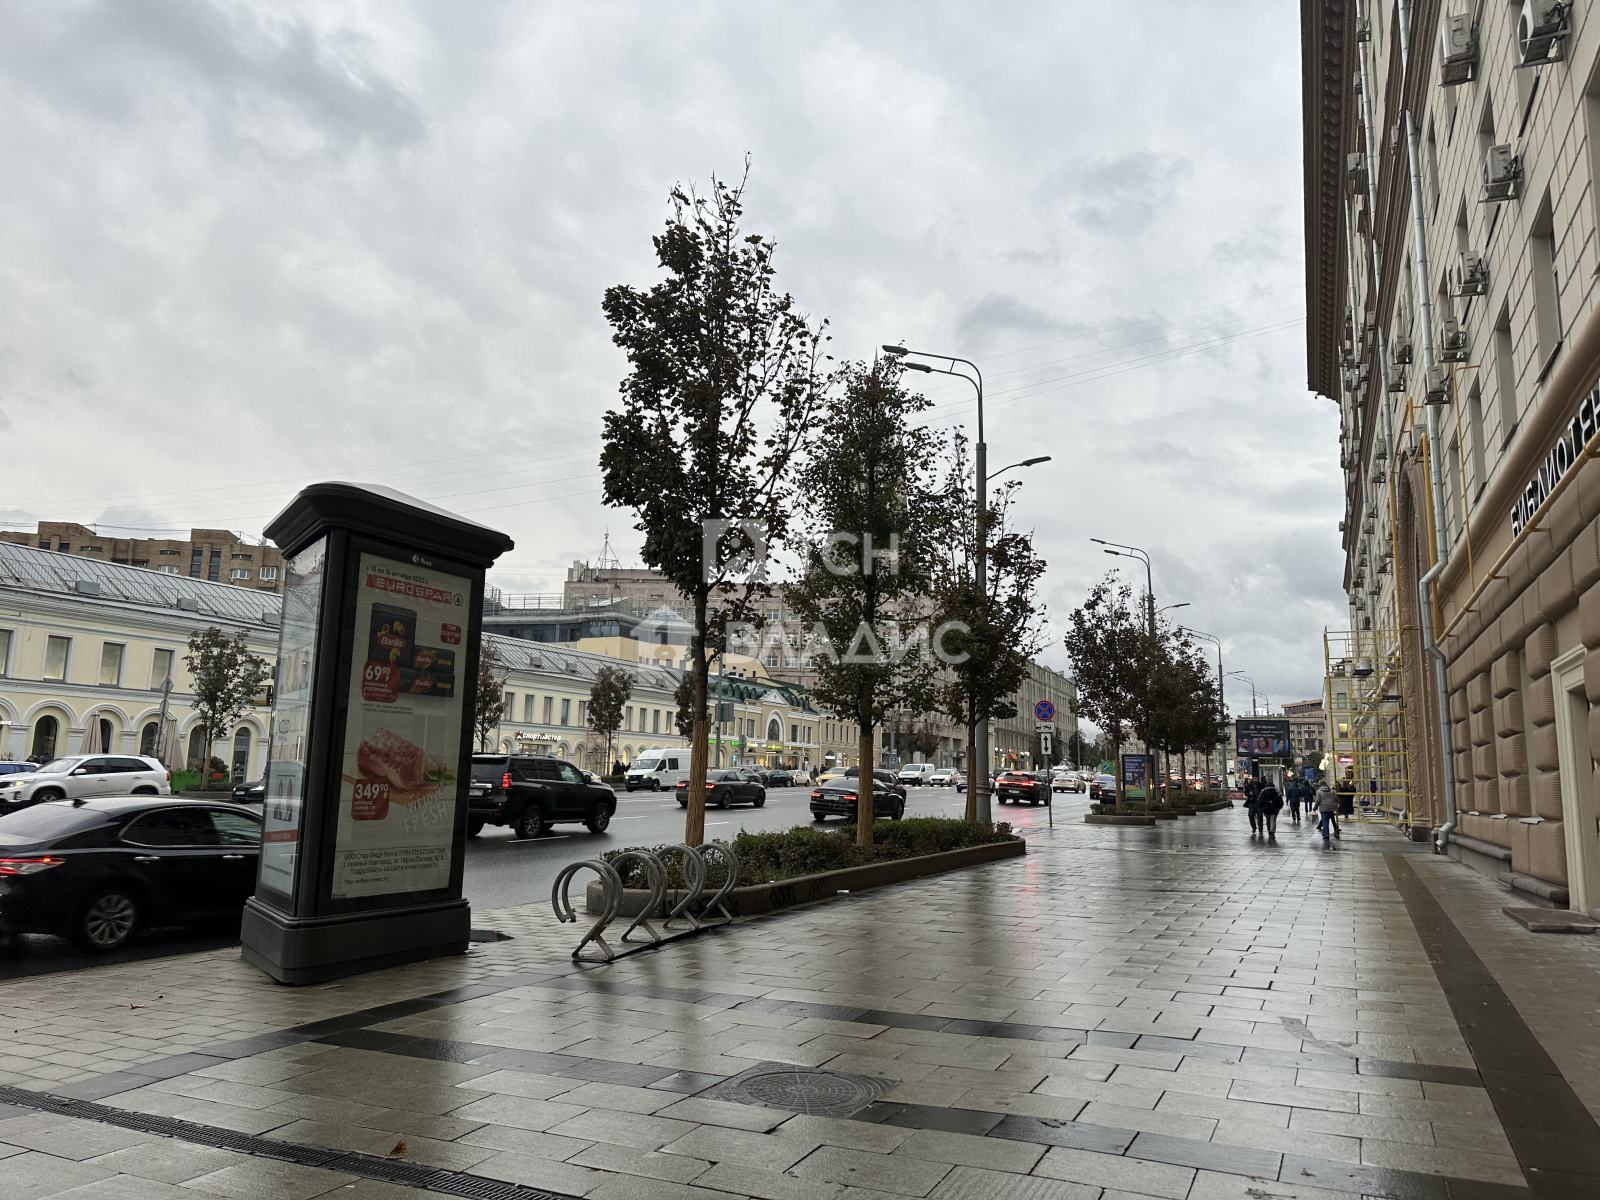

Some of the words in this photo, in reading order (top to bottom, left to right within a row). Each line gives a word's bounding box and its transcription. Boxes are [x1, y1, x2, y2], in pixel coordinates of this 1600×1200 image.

[420, 557, 432, 566] Russ
[391, 571, 412, 581] октября
[412, 575, 425, 584] 2023
[376, 577, 452, 603] EUROSPAR
[380, 636, 403, 648] Barilla
[416, 655, 432, 663] Barilla
[364, 664, 383, 681] 69
[415, 679, 431, 687] Barilla
[355, 783, 379, 799] 349
[379, 783, 389, 792] 90
[403, 800, 448, 837] FRESH
